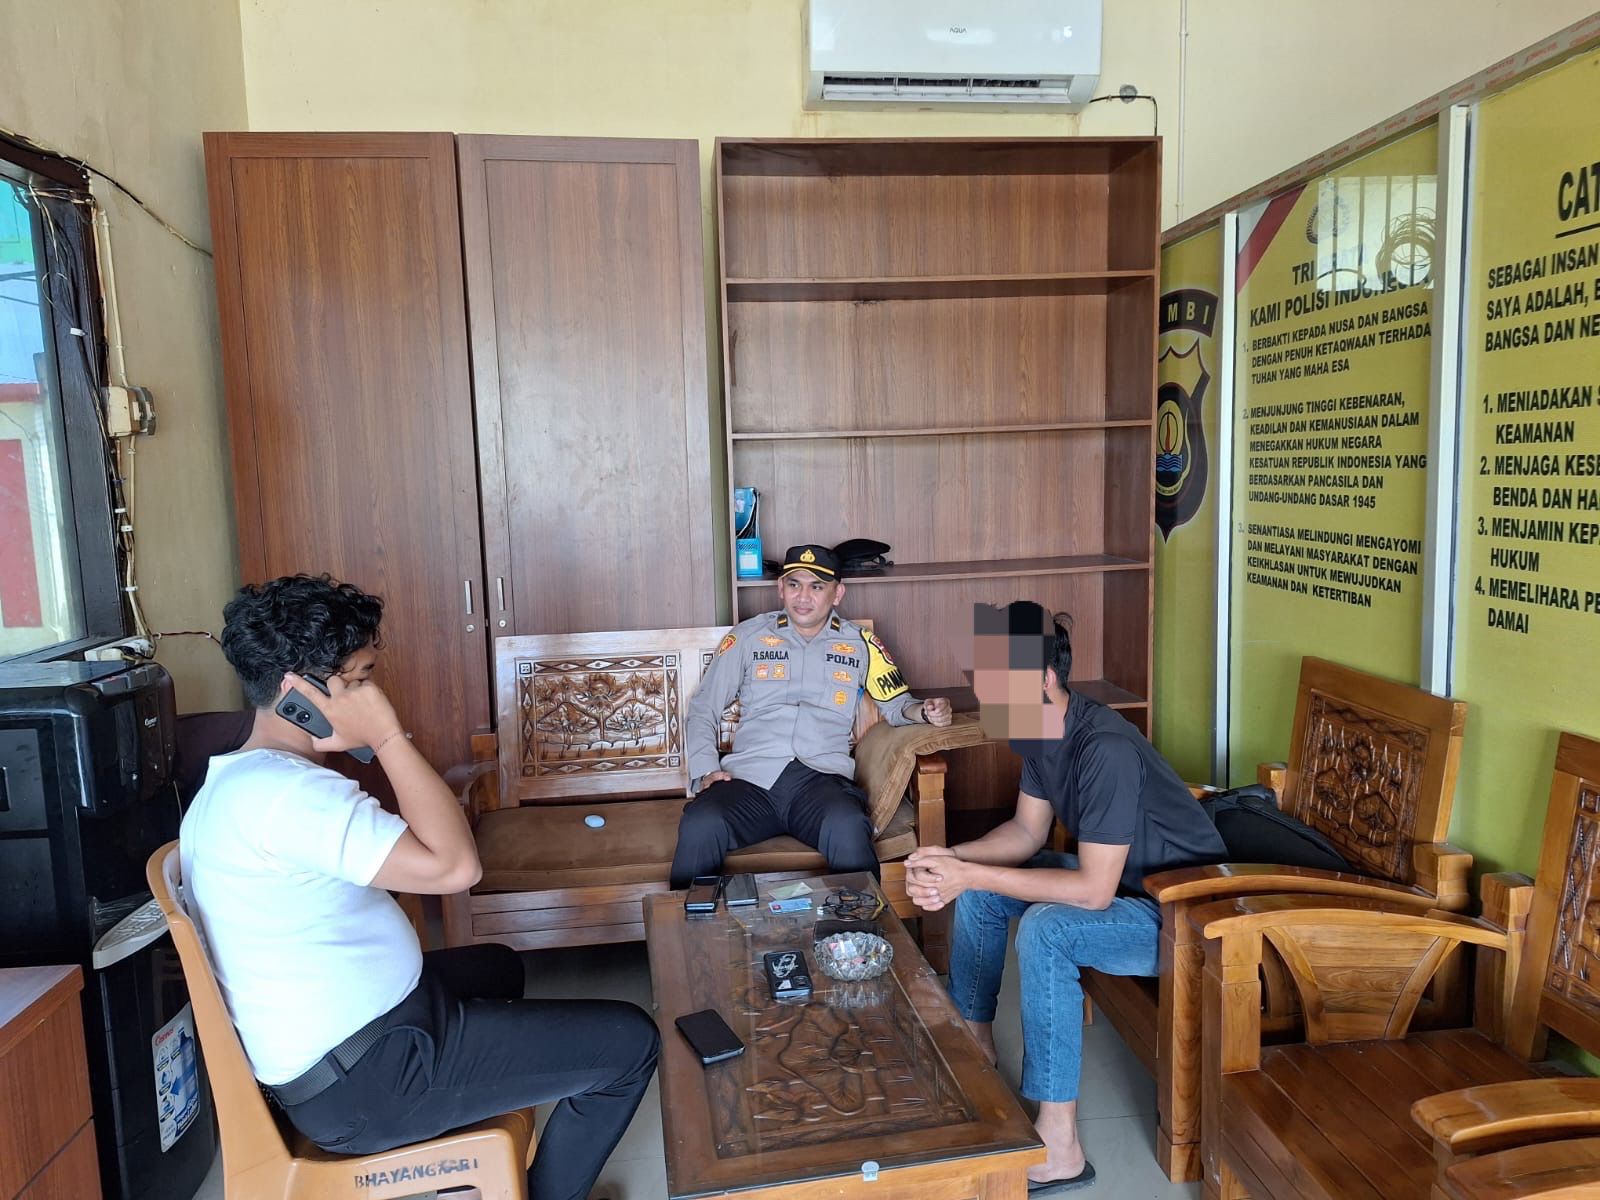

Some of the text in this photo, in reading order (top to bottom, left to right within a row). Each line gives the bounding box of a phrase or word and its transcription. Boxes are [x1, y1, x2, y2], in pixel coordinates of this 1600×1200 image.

[1557, 161, 1600, 222] CAT
[1292, 261, 1314, 285] TRI
[1488, 243, 1599, 289] SEBAGAI INSAN
[1250, 302, 1280, 327] KAMI
[1285, 289, 1329, 318] POLISI
[1487, 295, 1521, 321] SAYA
[1525, 281, 1589, 314] ADALAH,
[1252, 332, 1290, 351] BERBAKTI
[1292, 325, 1326, 342] KEPADA
[1329, 318, 1354, 334] NUSA
[1357, 312, 1378, 329] DAN
[1382, 301, 1428, 324] BANGSA
[1485, 324, 1539, 352] BANGSA
[1544, 318, 1575, 343] DAN
[1252, 352, 1282, 368] DENGAN
[1285, 346, 1313, 363] PENUH
[1315, 333, 1376, 356] KETAQWAAN
[1252, 359, 1350, 385] TUHAN YANG MAHA ESA
[1250, 401, 1304, 419] MENJUNJUNG
[1306, 398, 1337, 414] TINGGI
[1339, 392, 1405, 411] KEBENARAN,
[1483, 394, 1493, 414] 1.
[1497, 385, 1592, 413] MENIADAKAN
[1250, 412, 1419, 435] KEADILAN DAN KEMANUSIAAN DALAM
[1496, 421, 1575, 444] KEAMANAN
[1249, 435, 1382, 452] MENEGAKKAN HUKUM NEGARA
[1249, 455, 1427, 469] KESATUAN REPUBLIK INDONESIA YANG
[1480, 456, 1490, 475] 2.
[1494, 455, 1560, 475] MENJAGA
[1249, 474, 1384, 489] BERDASARKAN PANCASILA DAN
[1249, 491, 1376, 509] UNDANG-UNDANG DASAR 1945
[1493, 486, 1538, 508] BENDA
[1542, 488, 1572, 509] DAN
[1248, 524, 1295, 540] SENANTIASA
[1297, 528, 1353, 547] MELINDUNGI
[1355, 534, 1421, 555] MENGAYOMI
[1477, 516, 1488, 536] 3.
[1492, 517, 1564, 542] MENJAMIN
[1247, 539, 1418, 575] DAN MELAYANI MASYARAKAT DENGAN
[1490, 547, 1540, 572] HUKUM
[1247, 556, 1401, 593] KEIKHLASAN UNTUK MEWUJUDKAN
[1246, 572, 1372, 608] KEAMANAN DAN KETERTIBAN
[1475, 575, 1485, 595] 4.
[1489, 578, 1580, 611] MEMELIHARA
[1488, 608, 1529, 634] DAMAI
[826, 653, 860, 668] POLRI
